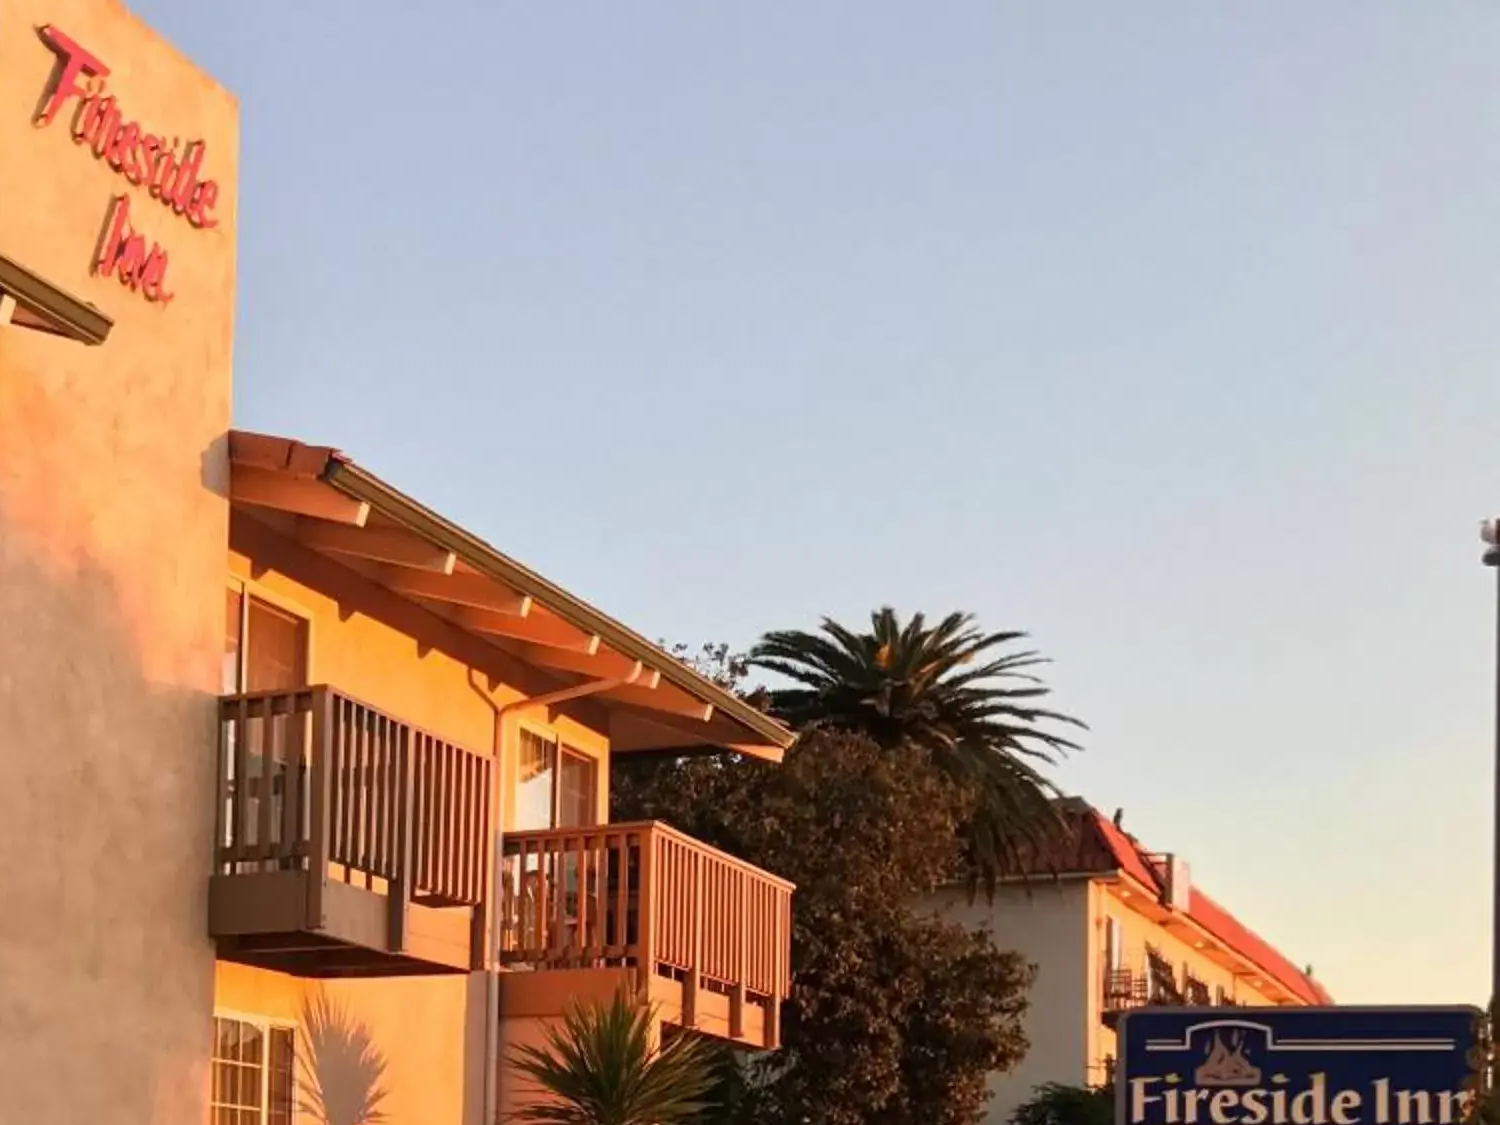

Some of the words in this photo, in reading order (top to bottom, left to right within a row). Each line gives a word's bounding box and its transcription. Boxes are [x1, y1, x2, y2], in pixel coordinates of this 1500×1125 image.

[33, 23, 219, 229] Fireside
[94, 193, 174, 304] Inn
[1128, 1073, 1363, 1125] Fireside
[1371, 1077, 1475, 1125] Inn
